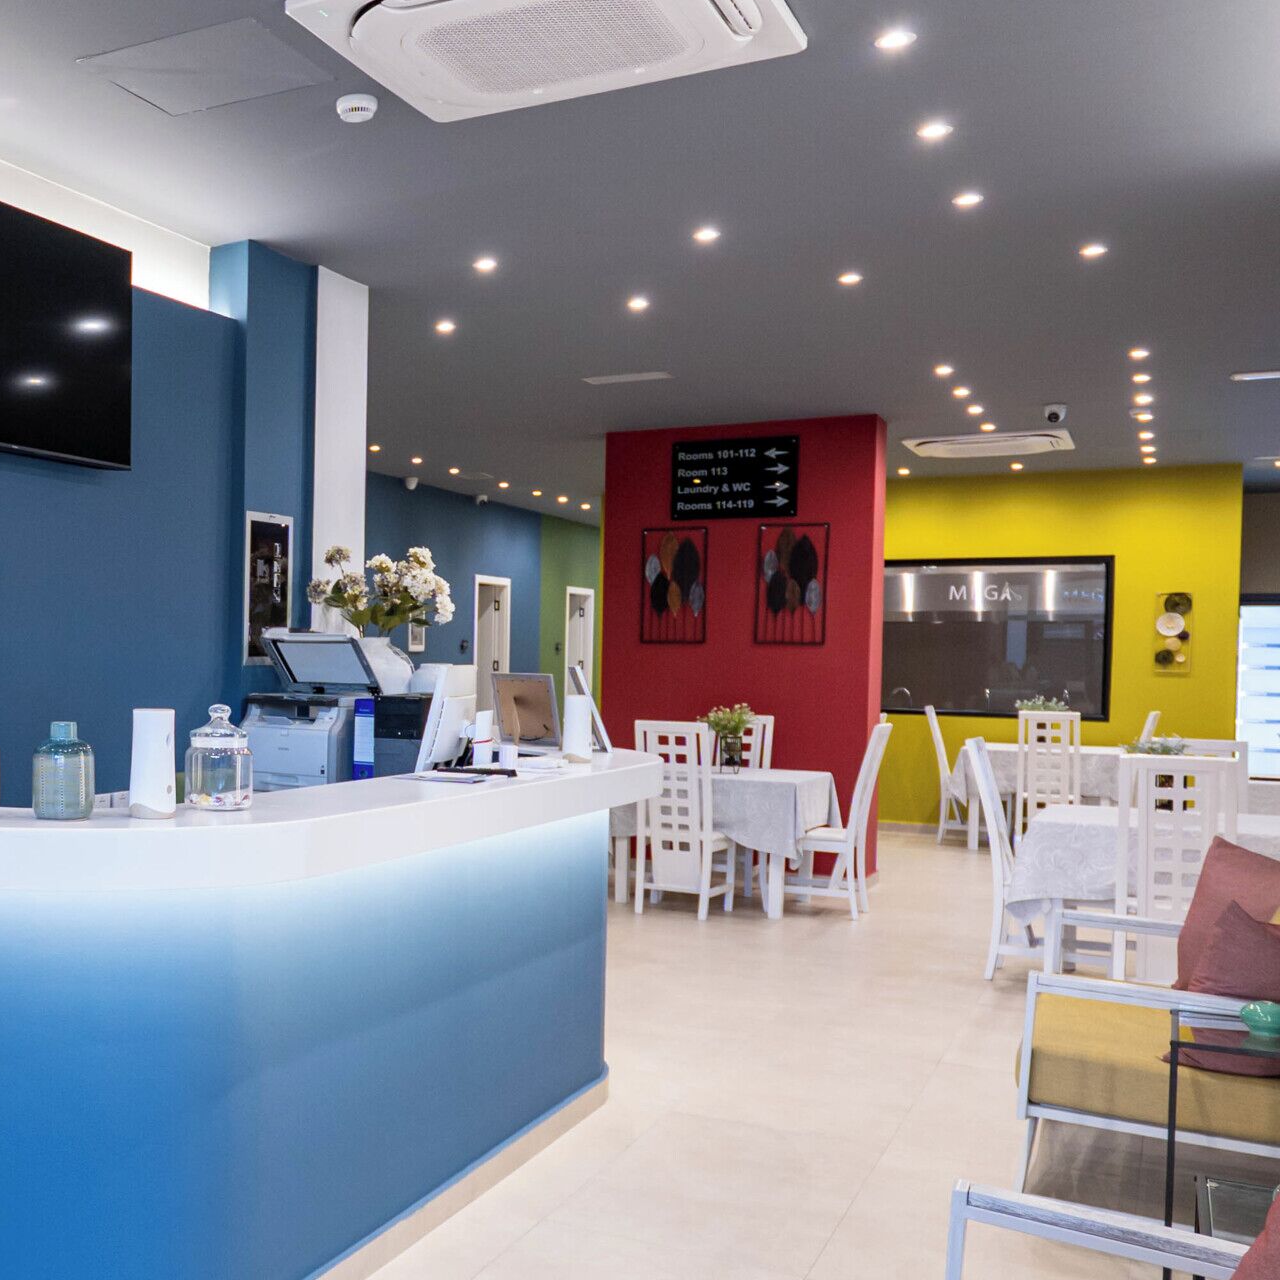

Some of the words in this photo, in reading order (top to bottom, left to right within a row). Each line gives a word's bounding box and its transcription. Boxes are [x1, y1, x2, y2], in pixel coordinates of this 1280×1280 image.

[678, 452, 714, 461] Rooms
[717, 448, 757, 459] 101-112
[677, 468, 708, 478] Room
[710, 467, 729, 476] 113
[677, 484, 719, 495] Laundry
[721, 483, 730, 492] &
[732, 482, 751, 492] WC
[676, 502, 713, 511] Rooms
[715, 499, 755, 510] 114-119
[948, 584, 1012, 602] MGA
